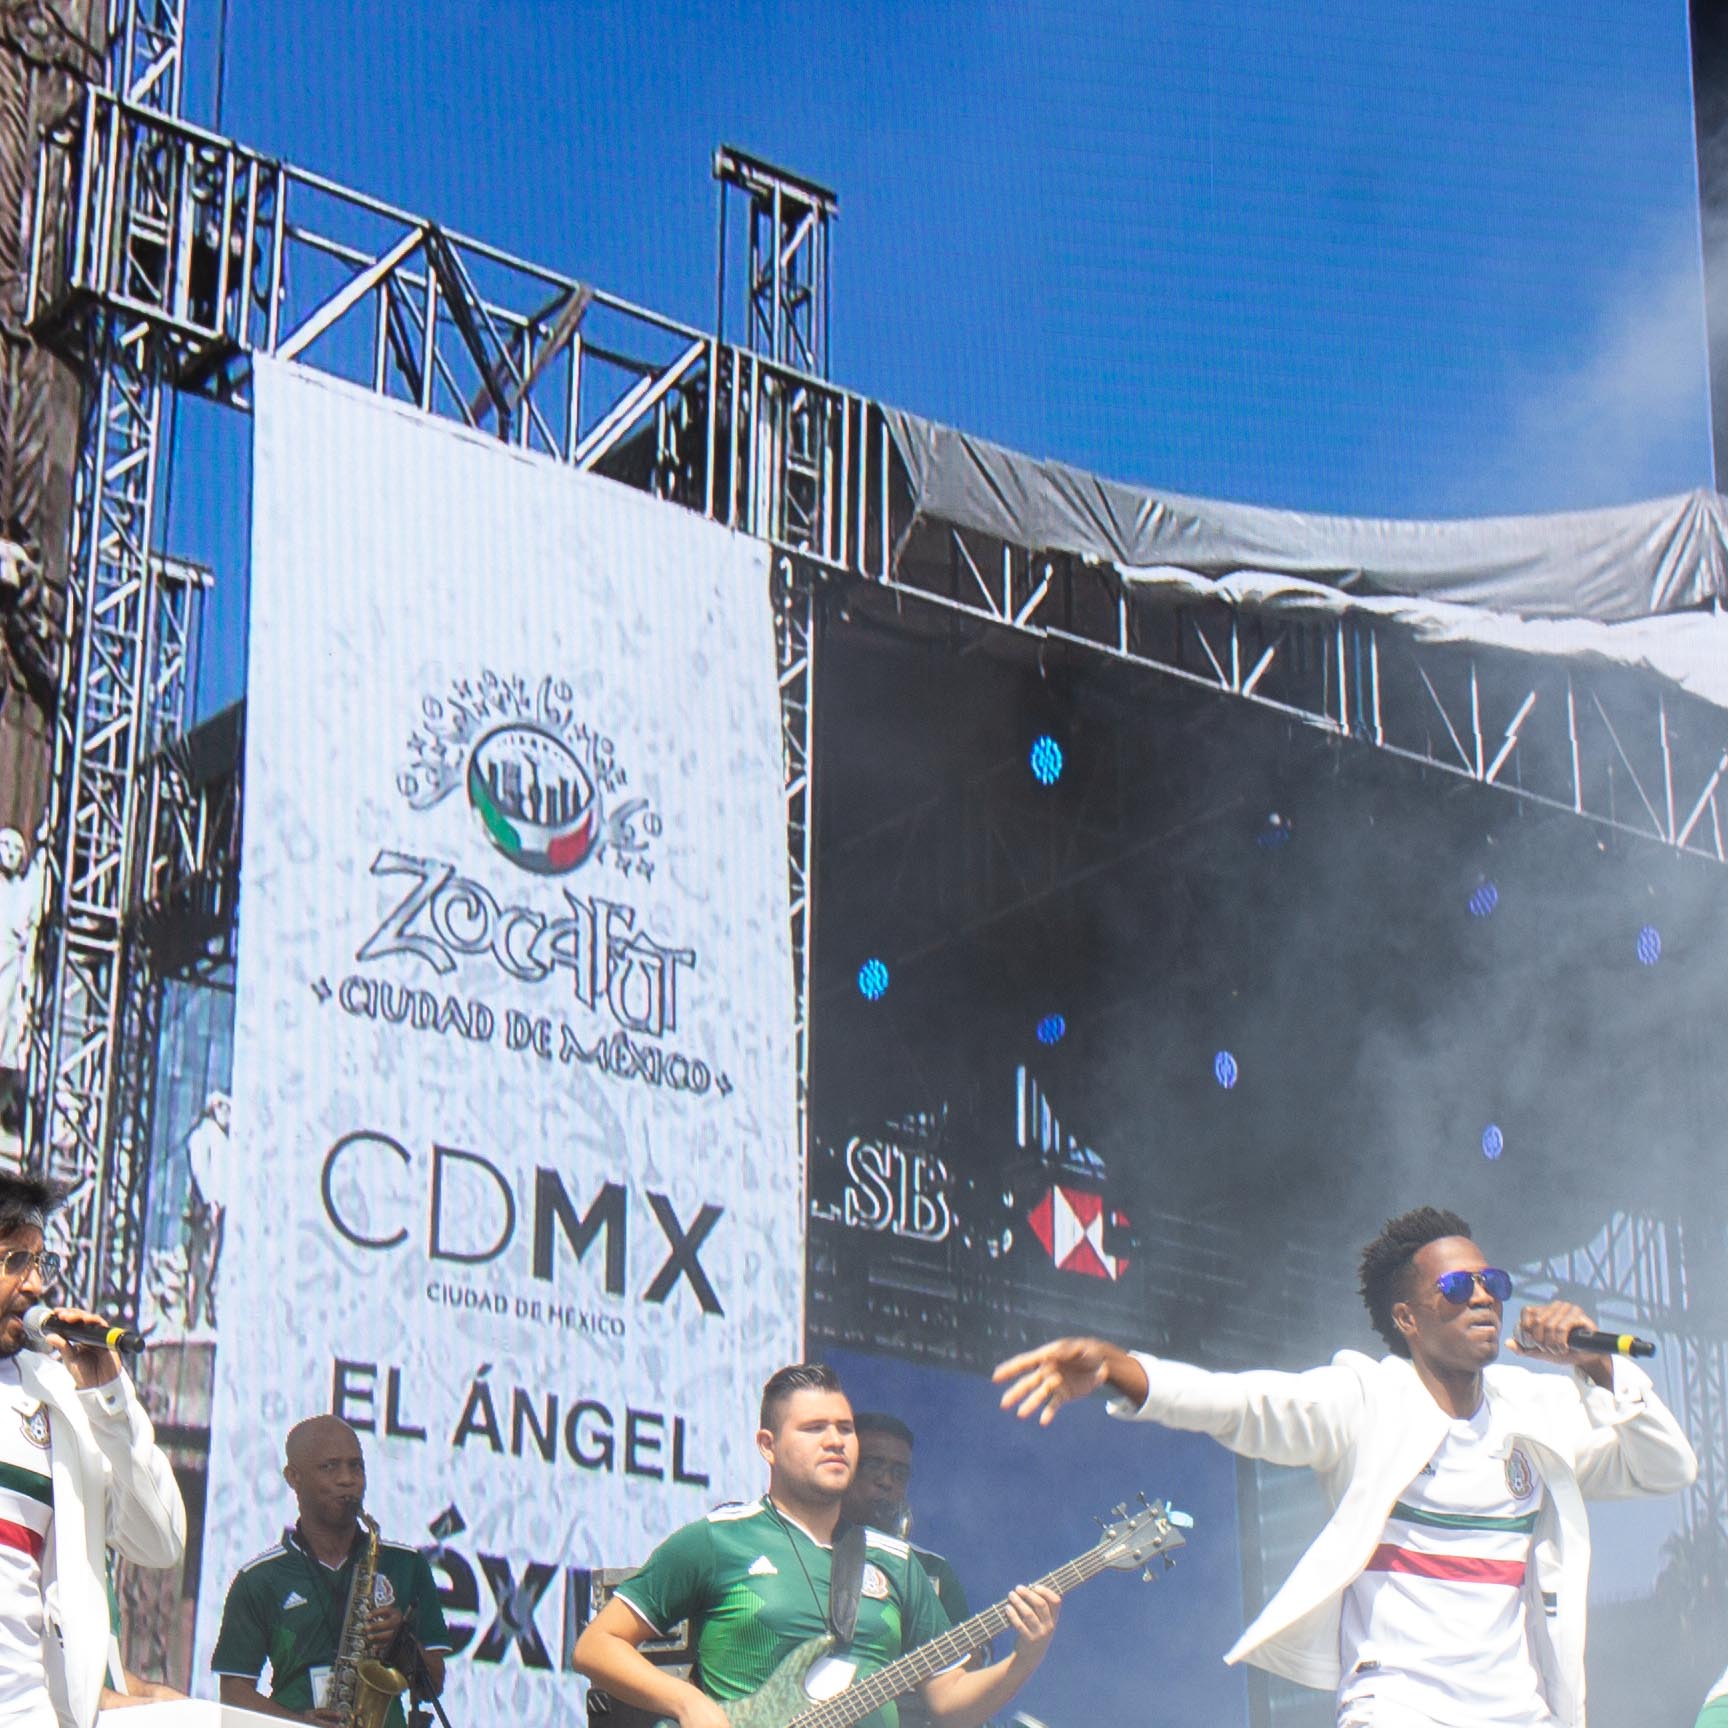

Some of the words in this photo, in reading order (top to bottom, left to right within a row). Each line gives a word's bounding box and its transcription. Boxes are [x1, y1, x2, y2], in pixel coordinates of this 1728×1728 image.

[339, 975, 494, 1042] CIUDAD
[505, 1009, 553, 1062] DE
[320, 1130, 725, 1319] CDMX
[426, 1282, 508, 1315] CIUDAD
[515, 1298, 542, 1322] DE
[332, 1357, 426, 1441] EL
[453, 1362, 710, 1488] ÁNGEL
